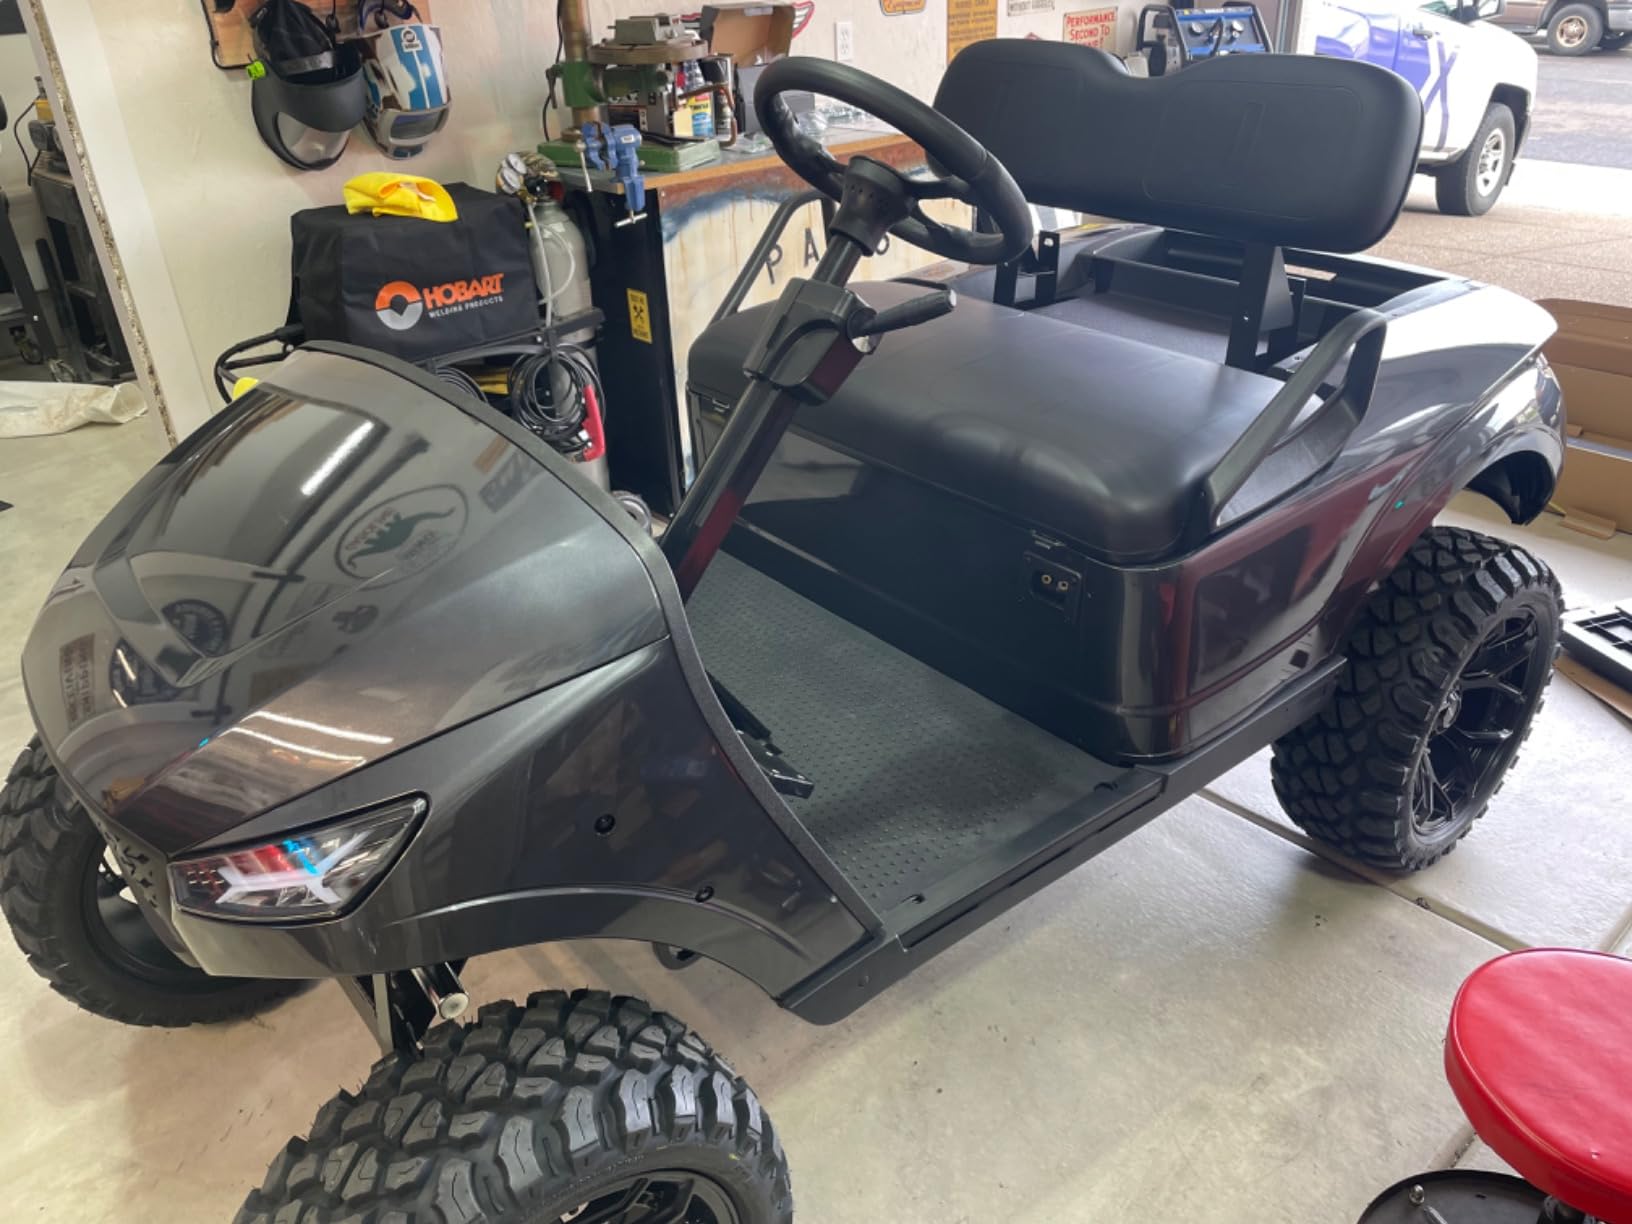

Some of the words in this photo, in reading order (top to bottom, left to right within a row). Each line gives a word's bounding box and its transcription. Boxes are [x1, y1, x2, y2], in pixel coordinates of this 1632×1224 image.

[1066, 11, 1116, 27] PERFORMANCE
[1070, 28, 1099, 41] SECOND
[422, 273, 504, 310] HOBART
[428, 304, 463, 319] WELDING
[464, 296, 504, 311] PRODUCTS
